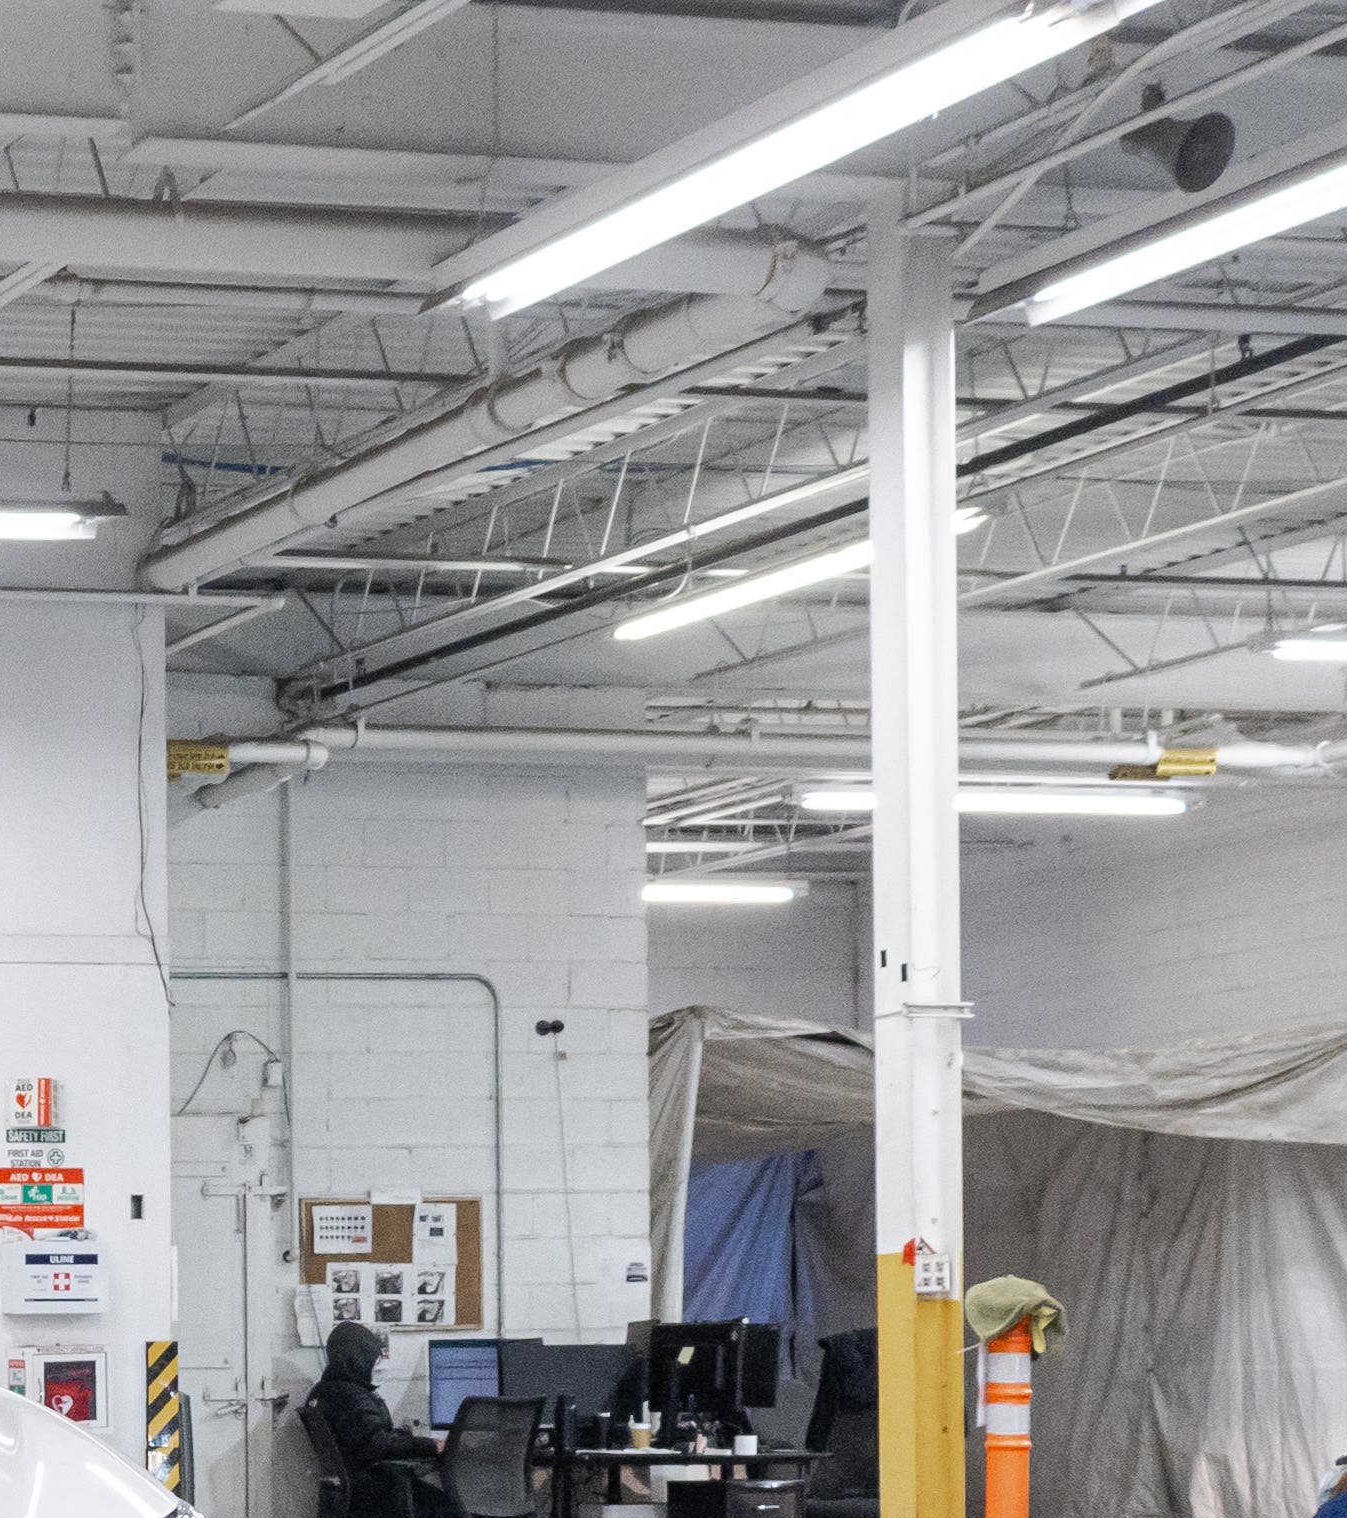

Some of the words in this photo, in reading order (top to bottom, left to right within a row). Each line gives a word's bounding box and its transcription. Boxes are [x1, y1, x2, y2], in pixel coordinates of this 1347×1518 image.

[8, 1130, 38, 1142] SAFETY
[40, 1130, 64, 1142] FIRST
[8, 1149, 29, 1157] FIRST
[30, 1149, 43, 1157] AID
[11, 1159, 41, 1167] STATION
[10, 1173, 29, 1182] AED
[45, 1173, 64, 1182] DEA
[49, 1255, 75, 1264] ULINE
